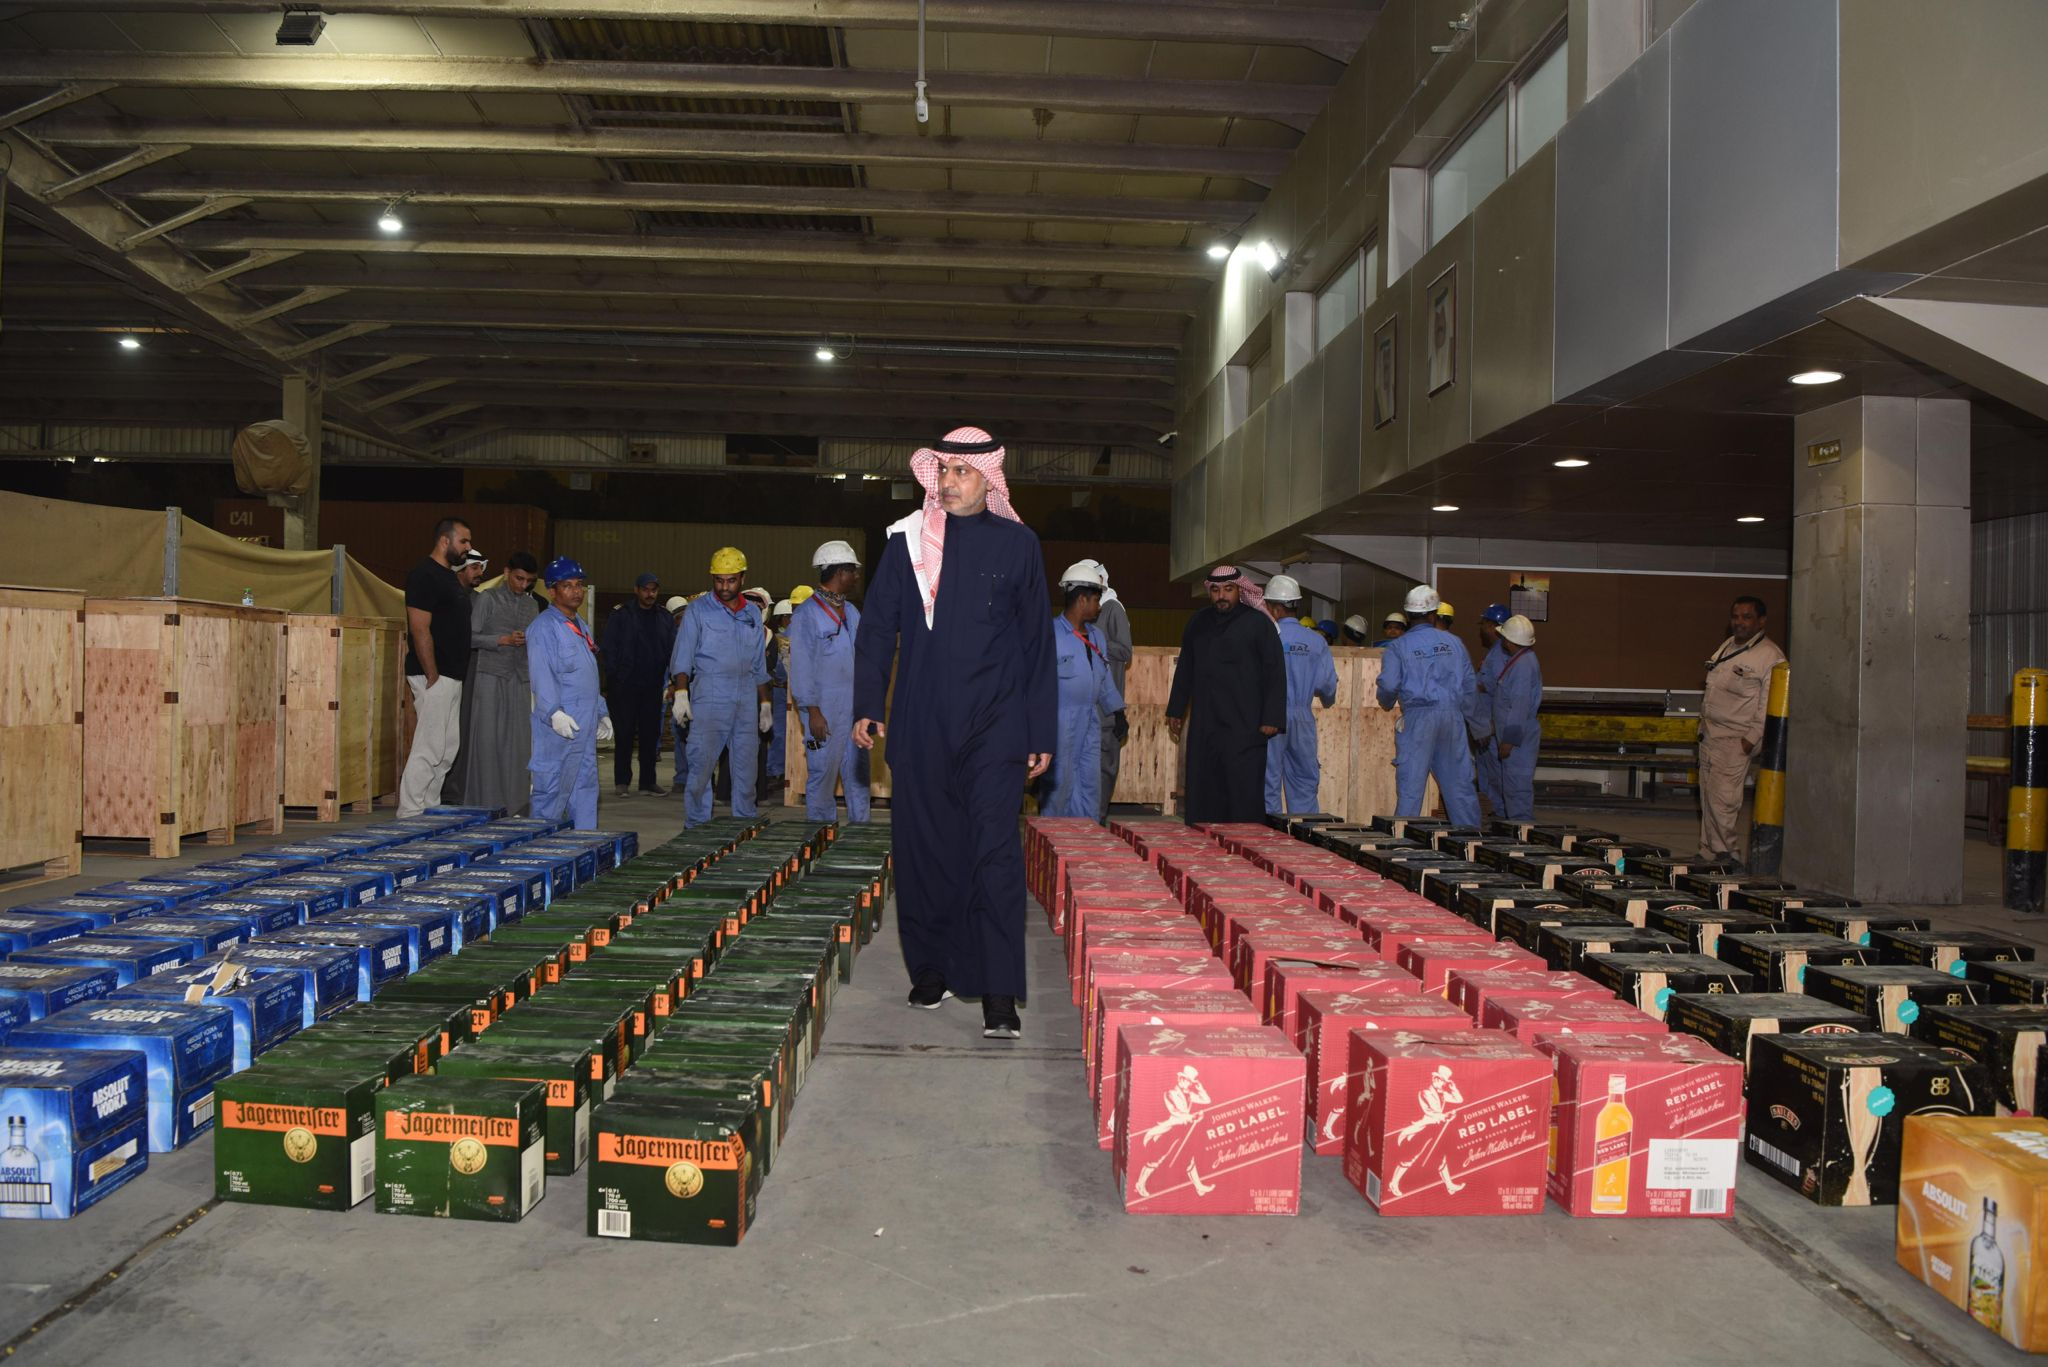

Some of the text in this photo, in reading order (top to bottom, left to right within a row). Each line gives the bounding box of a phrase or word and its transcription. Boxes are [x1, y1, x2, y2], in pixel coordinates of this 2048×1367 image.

[230, 511, 253, 527] CAI
[382, 944, 402, 961] ABSOLUT
[152, 958, 180, 975] ABSOLUT
[384, 955, 401, 970] VODKA
[92, 1075, 131, 1107] ABSOLUT
[1665, 1080, 1722, 1107] RED LABEL
[96, 1093, 128, 1119] VODKA
[1206, 1106, 1286, 1140] RED LABEL
[1458, 1104, 1533, 1139] RED LABEL
[1597, 1141, 1628, 1155] RED LABEL
[1, 1167, 36, 1176] ABSOLUT
